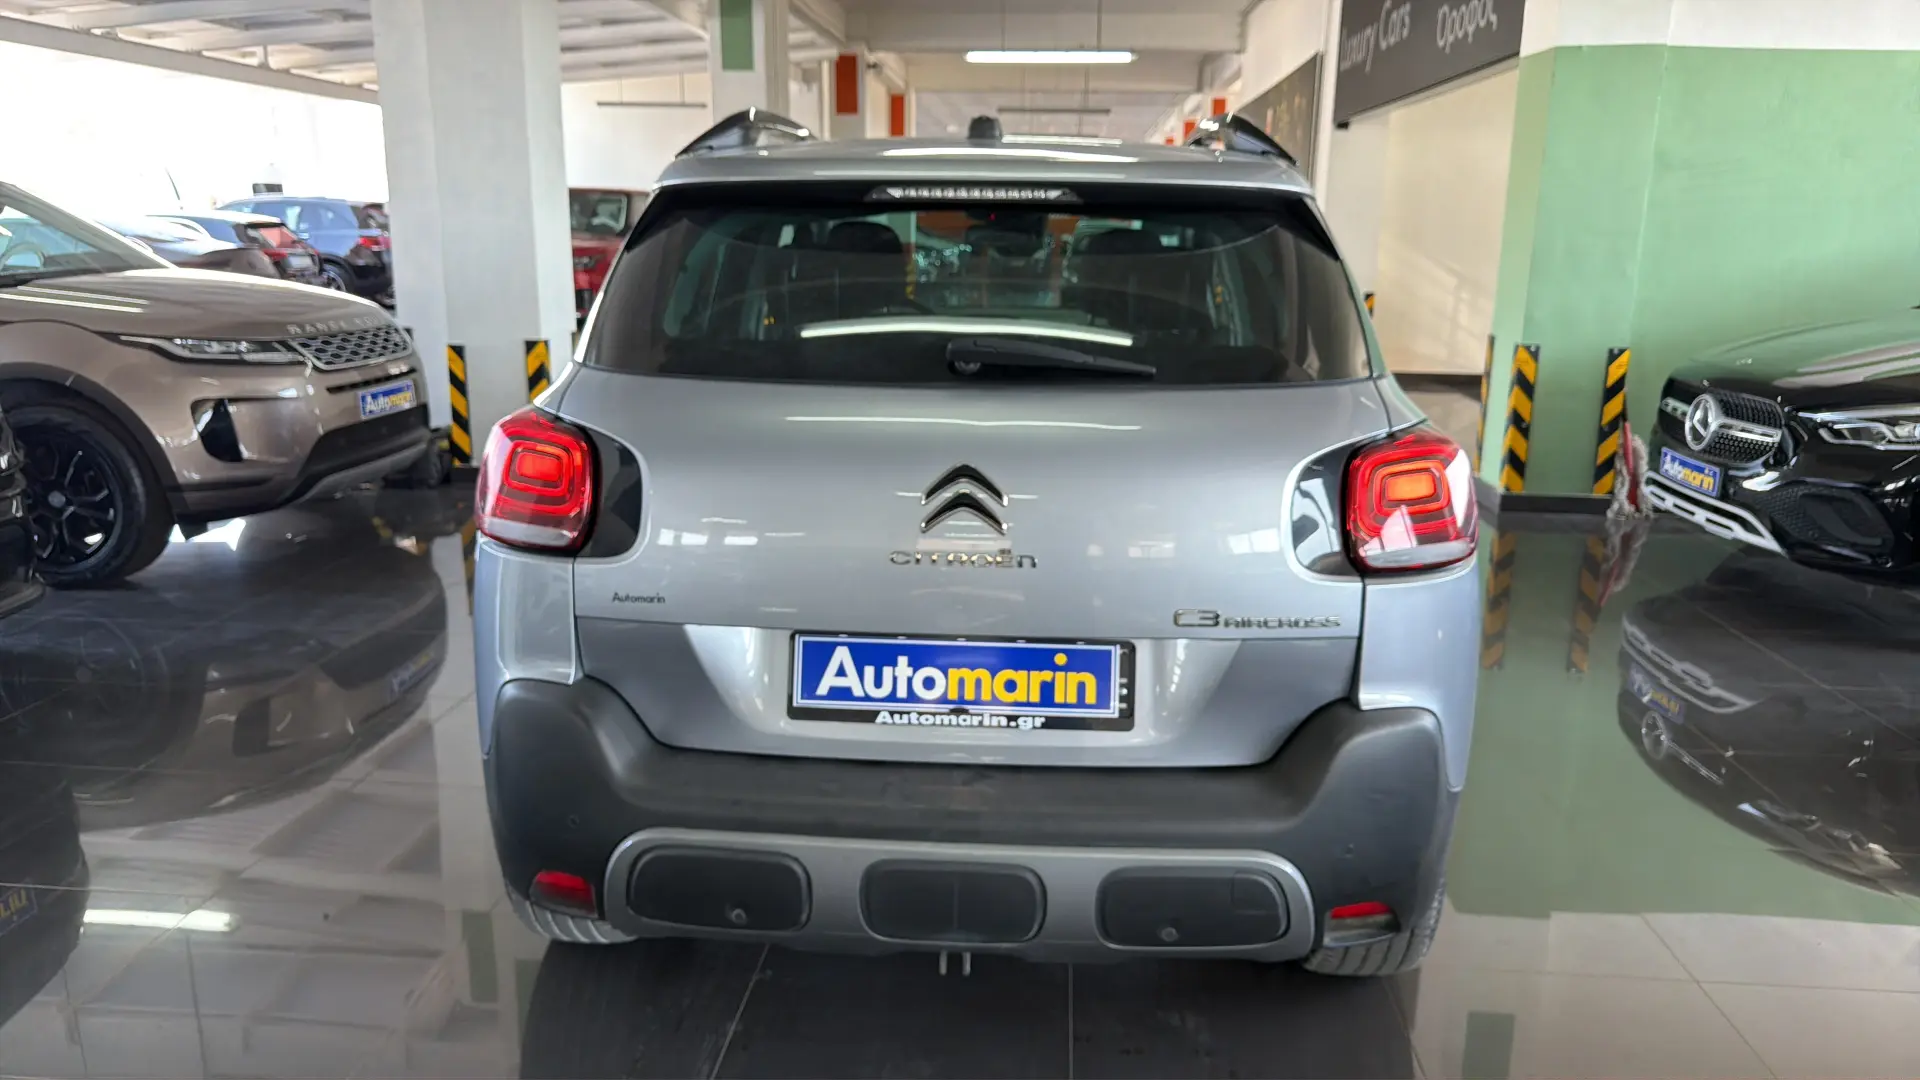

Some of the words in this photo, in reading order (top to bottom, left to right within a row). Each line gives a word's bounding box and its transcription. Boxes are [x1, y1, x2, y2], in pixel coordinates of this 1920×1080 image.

[1379, 0, 1411, 51] Cars
[611, 591, 666, 604] Automarin
[1173, 608, 1221, 627] C3
[1223, 615, 1341, 629] AIRCROSS
[815, 645, 1097, 705] Automarin
[874, 709, 1046, 730] Automarin.gr
